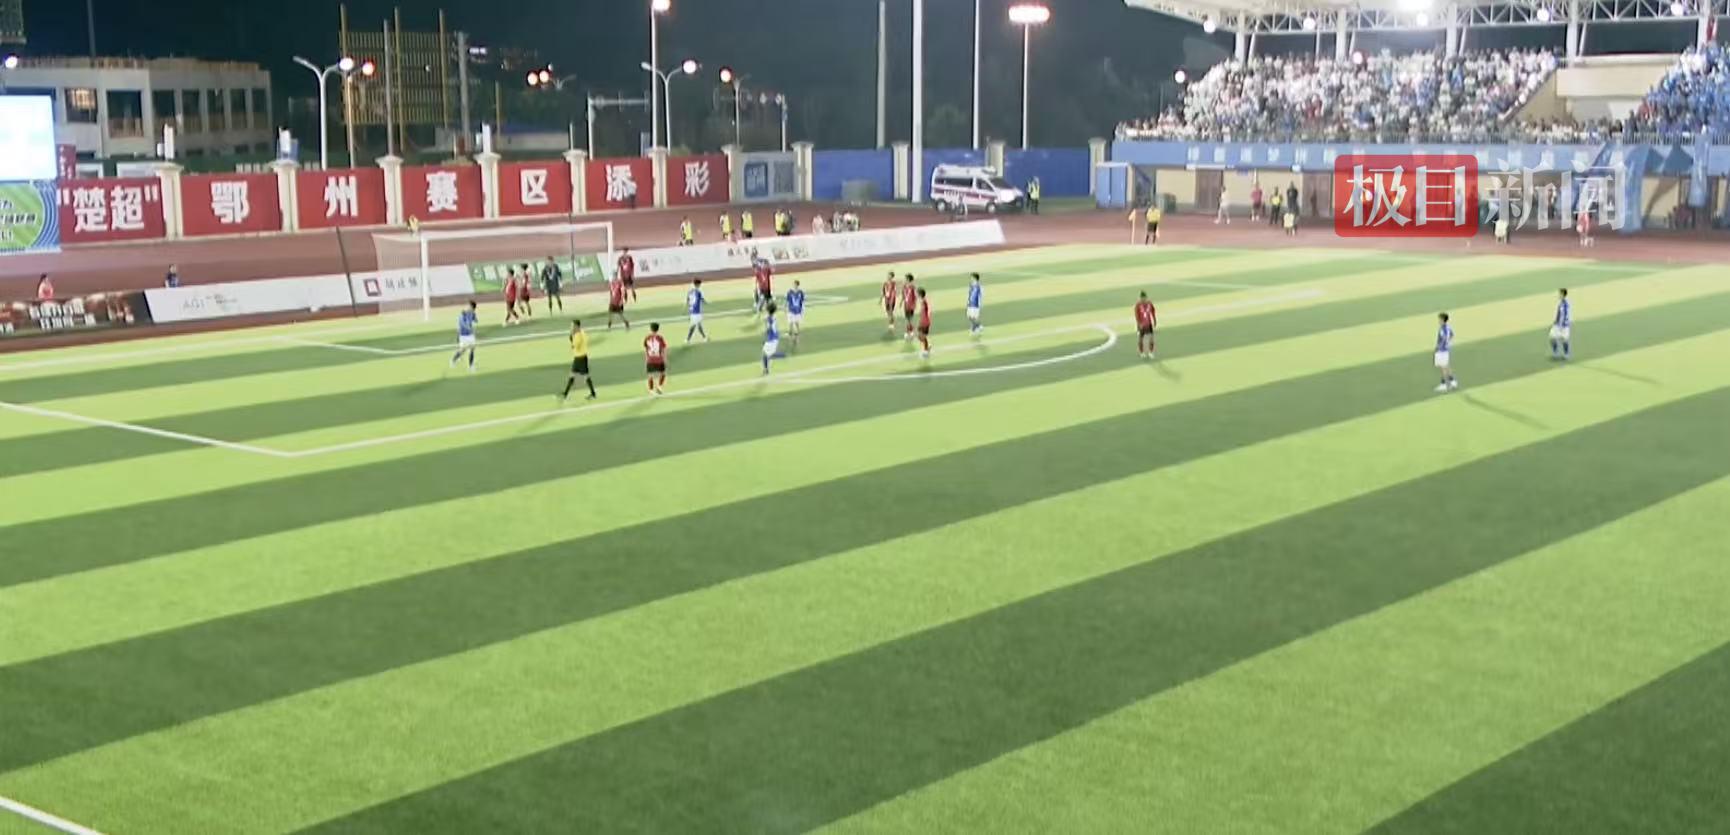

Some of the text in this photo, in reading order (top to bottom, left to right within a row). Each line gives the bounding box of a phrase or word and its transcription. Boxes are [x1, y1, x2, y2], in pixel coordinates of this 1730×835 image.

[211, 181, 249, 224] 鄂
[324, 176, 358, 218] 州
[426, 171, 458, 213] 赛
[520, 168, 549, 206] 区
[685, 161, 710, 198] 彩
